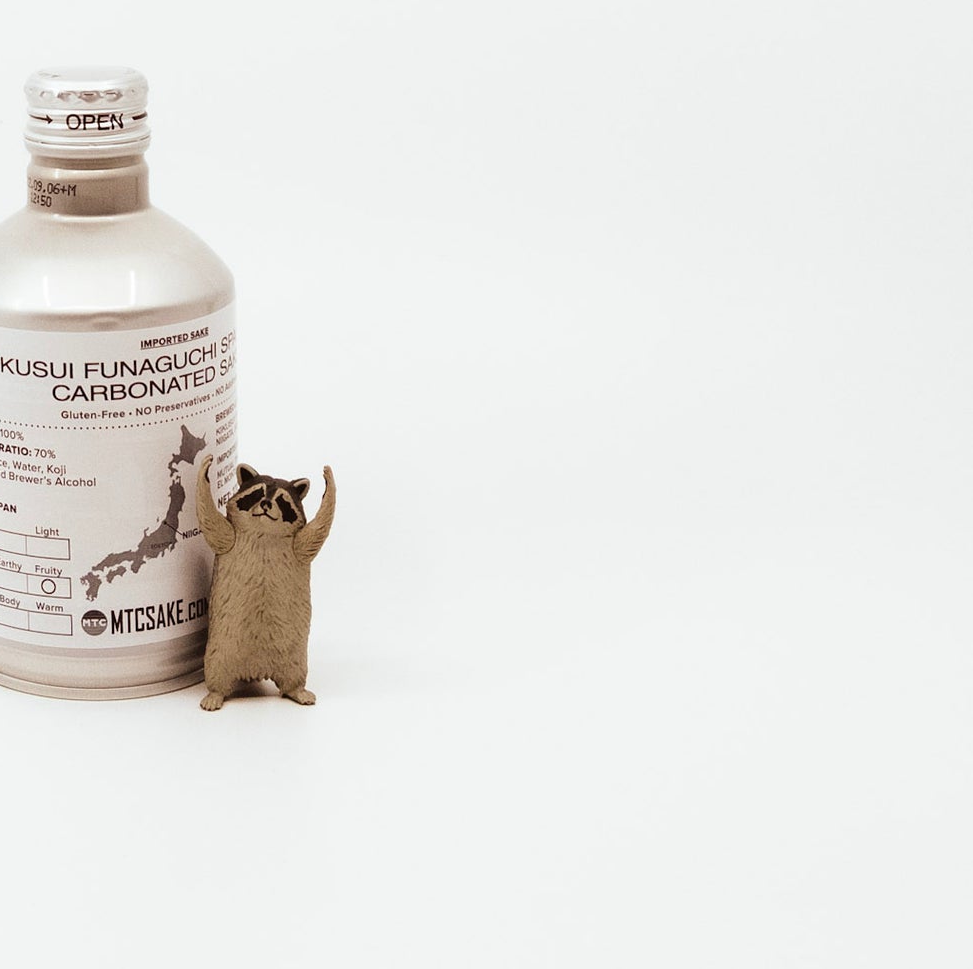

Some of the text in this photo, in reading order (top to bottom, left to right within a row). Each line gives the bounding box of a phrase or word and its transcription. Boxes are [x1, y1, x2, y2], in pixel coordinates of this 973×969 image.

[66, 113, 124, 130] OPEN
[140, 326, 209, 350] IMPORTED SAKE
[84, 342, 217, 379] FUNAGUCHI
[52, 365, 216, 402] CARBONATED
[61, 410, 126, 420] Gluten-Free
[135, 406, 152, 417] NO
[155, 392, 211, 414] Preservatives
[0, 428, 25, 442] 100%
[34, 448, 57, 460] 70%
[12, 460, 45, 474] Water,
[46, 464, 68, 477] Koji
[8, 471, 53, 486] Brewer's
[54, 477, 98, 488] Alcohol
[35, 526, 60, 537] Light
[34, 564, 63, 578] Fruity
[0, 594, 21, 608] Body
[36, 601, 64, 612] Warm
[82, 618, 108, 627] MTC
